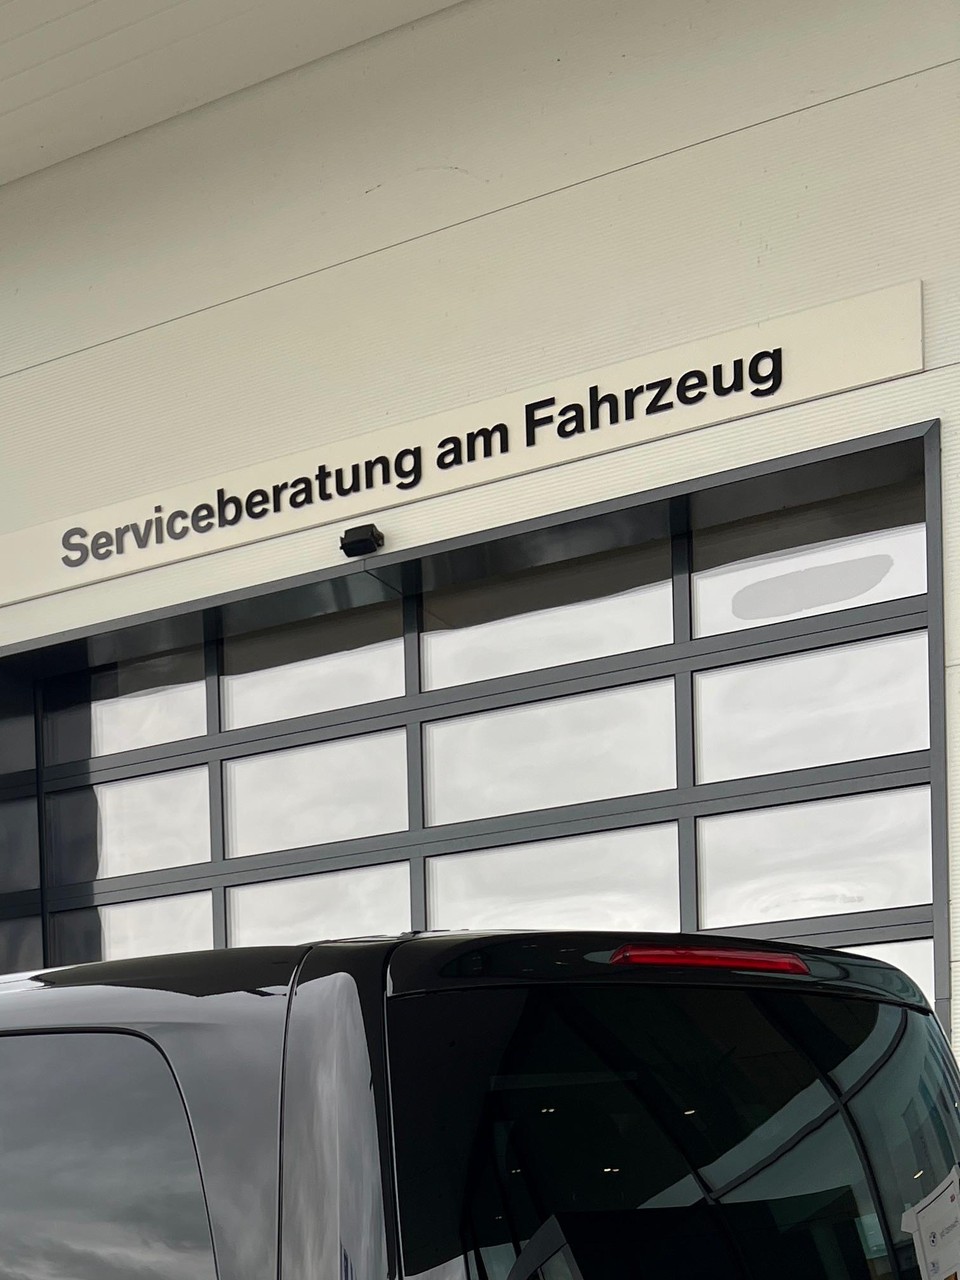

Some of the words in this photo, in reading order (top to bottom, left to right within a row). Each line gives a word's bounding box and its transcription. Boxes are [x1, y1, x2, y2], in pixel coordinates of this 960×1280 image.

[61, 445, 424, 568] Serviceberatung
[436, 422, 510, 470] am
[524, 347, 783, 448] Fahrzeug
